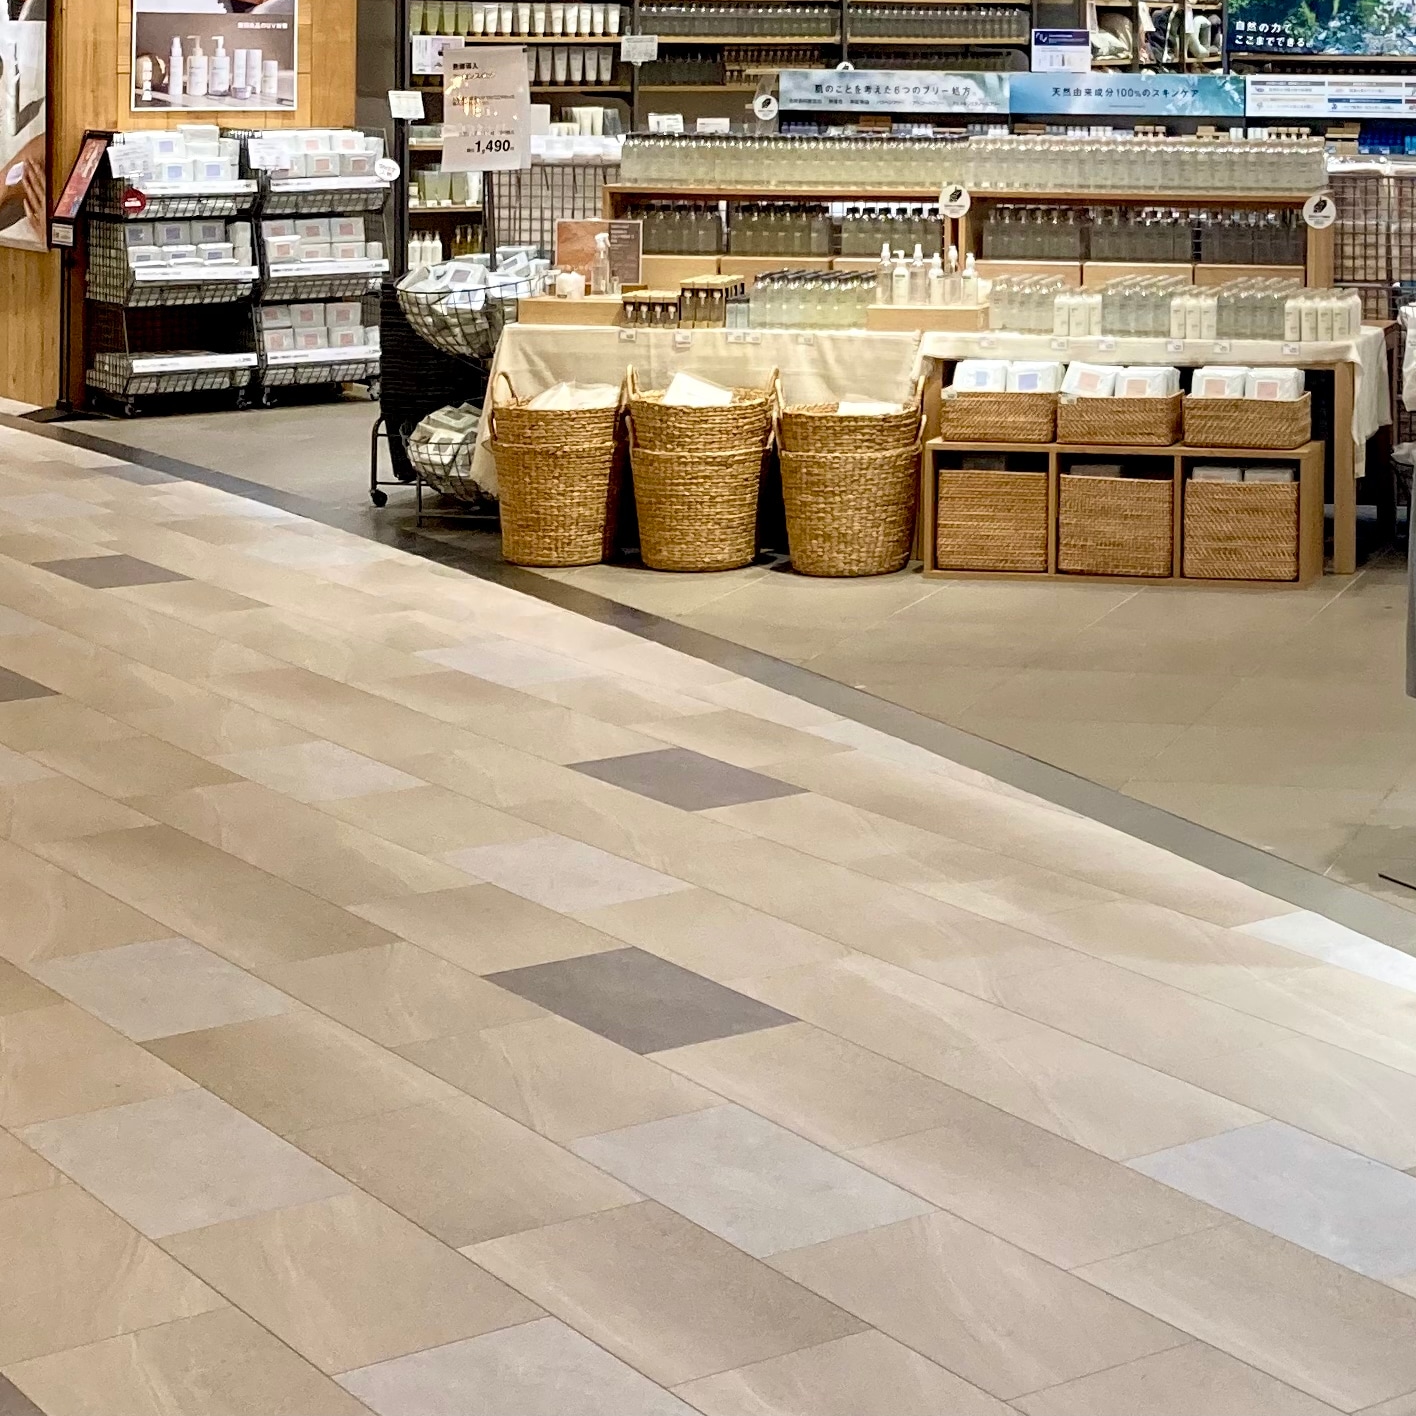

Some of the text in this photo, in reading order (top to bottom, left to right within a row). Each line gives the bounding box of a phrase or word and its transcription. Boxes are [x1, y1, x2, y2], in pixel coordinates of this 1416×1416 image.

[1051, 87, 1200, 99] 天然由来成分100%のスキンケア
